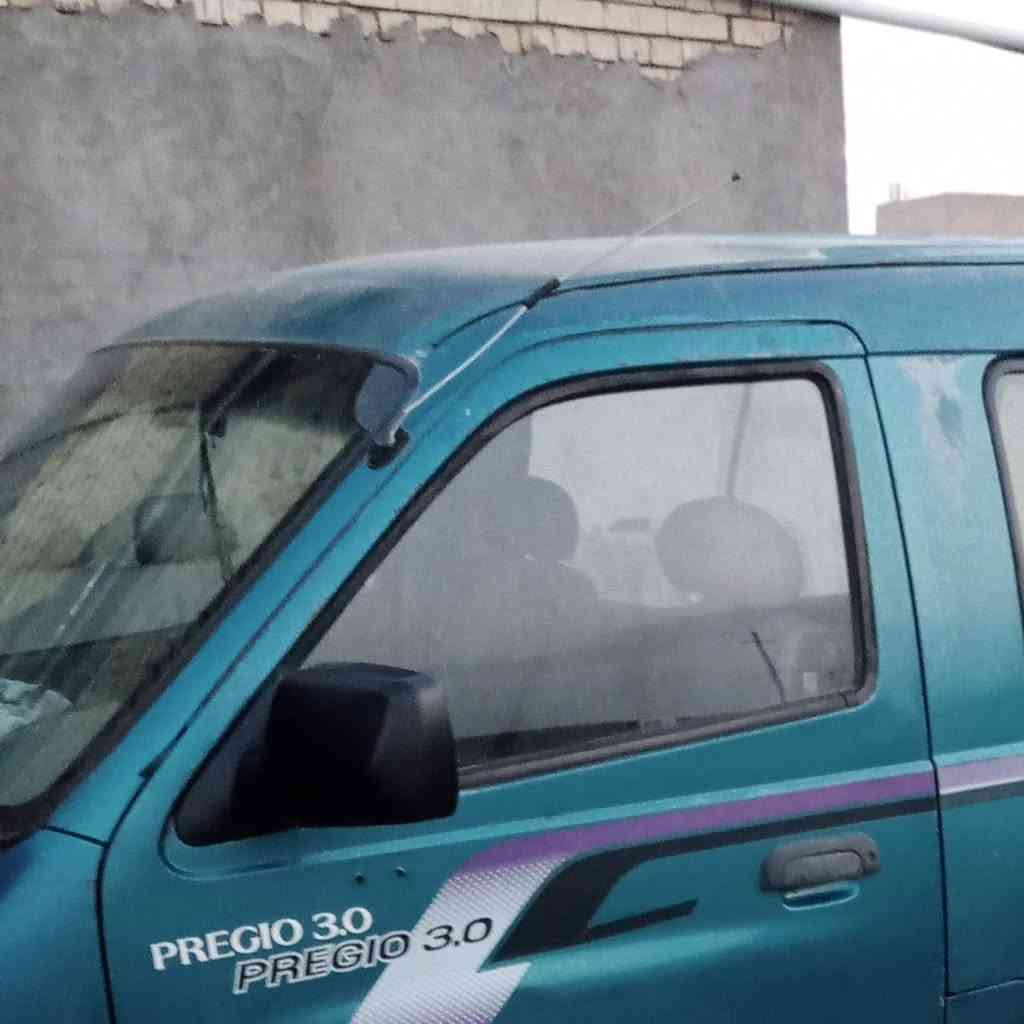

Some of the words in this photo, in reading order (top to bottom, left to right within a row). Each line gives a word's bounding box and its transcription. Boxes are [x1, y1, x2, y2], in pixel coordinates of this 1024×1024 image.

[150, 918, 303, 970] PREGIO
[312, 907, 373, 940] 3.0
[233, 931, 411, 994] PREGIO
[423, 917, 493, 952] 3.0
